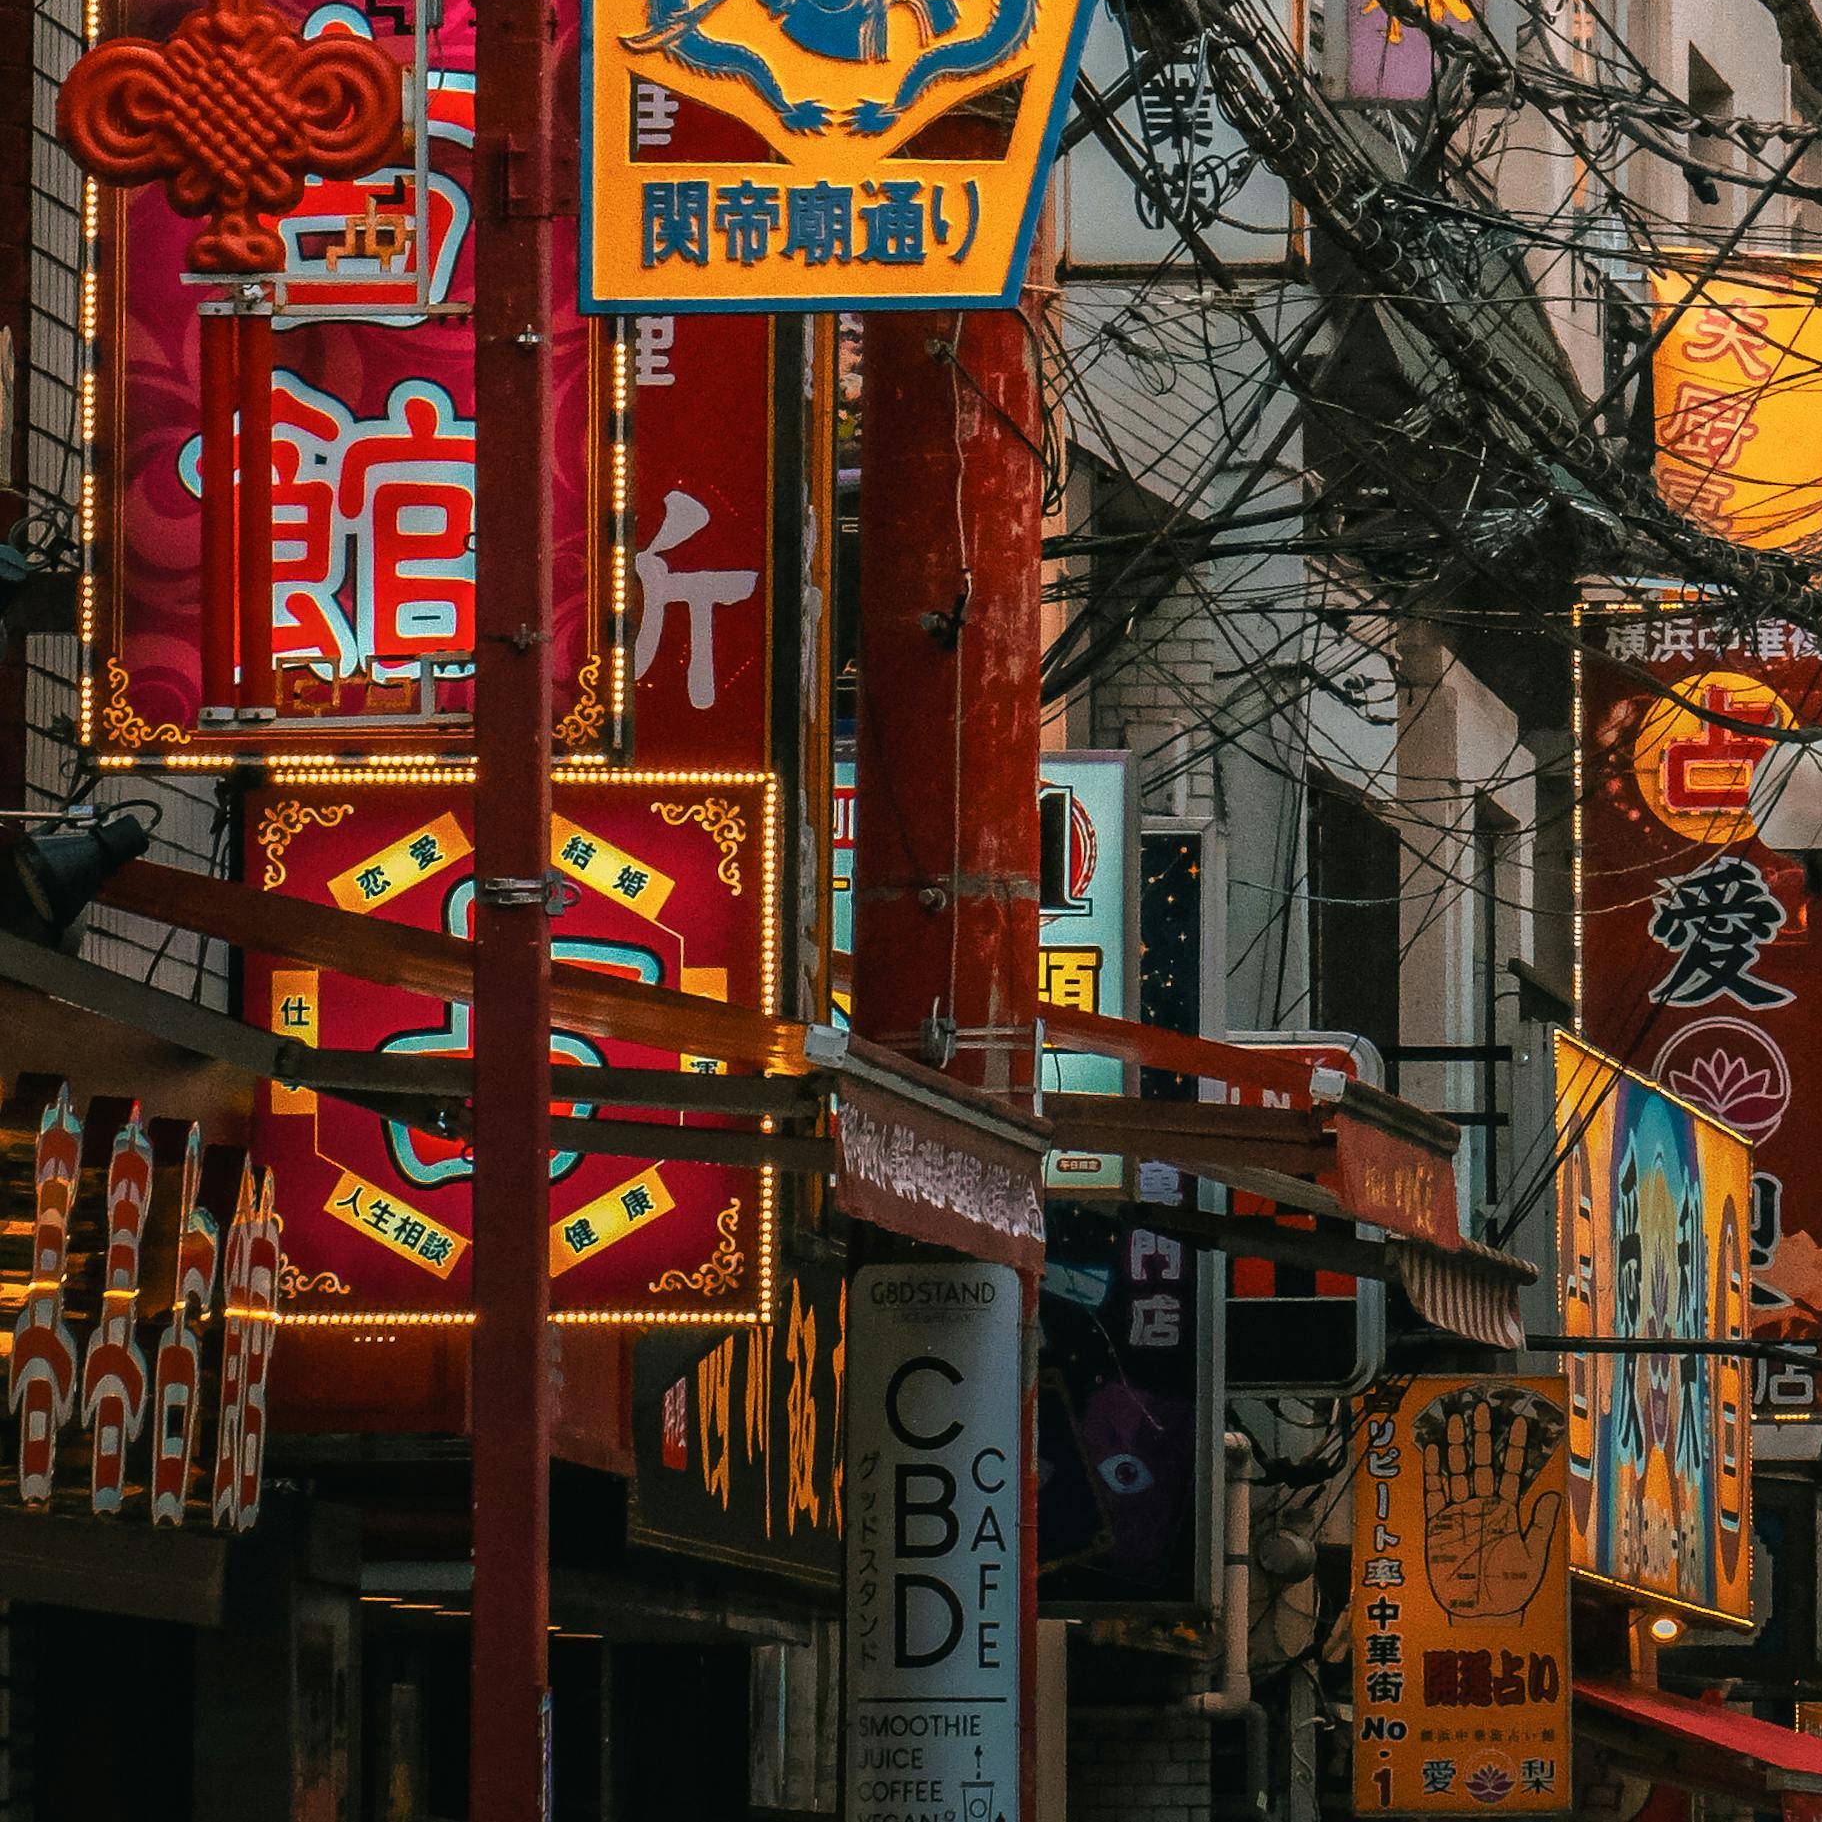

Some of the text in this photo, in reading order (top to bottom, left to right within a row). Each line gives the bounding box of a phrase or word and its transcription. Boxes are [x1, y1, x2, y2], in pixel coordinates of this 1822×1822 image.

[640, 177, 983, 266] 関帝廟通り
[356, 834, 444, 901] 恋愛
[560, 835, 649, 900] 結婚
[1647, 856, 1796, 1010] 愛
[336, 1186, 454, 1267] 人生相談
[563, 1184, 656, 1253] 健康
[885, 1355, 965, 1670] CBD
[971, 1447, 1006, 1670] CAFE
[858, 1714, 982, 1738] SMOOTHIE
[858, 1747, 924, 1770] JUICE
[858, 1780, 944, 1802] COFFEE
[1423, 1758, 1555, 1796] 愛 梨
